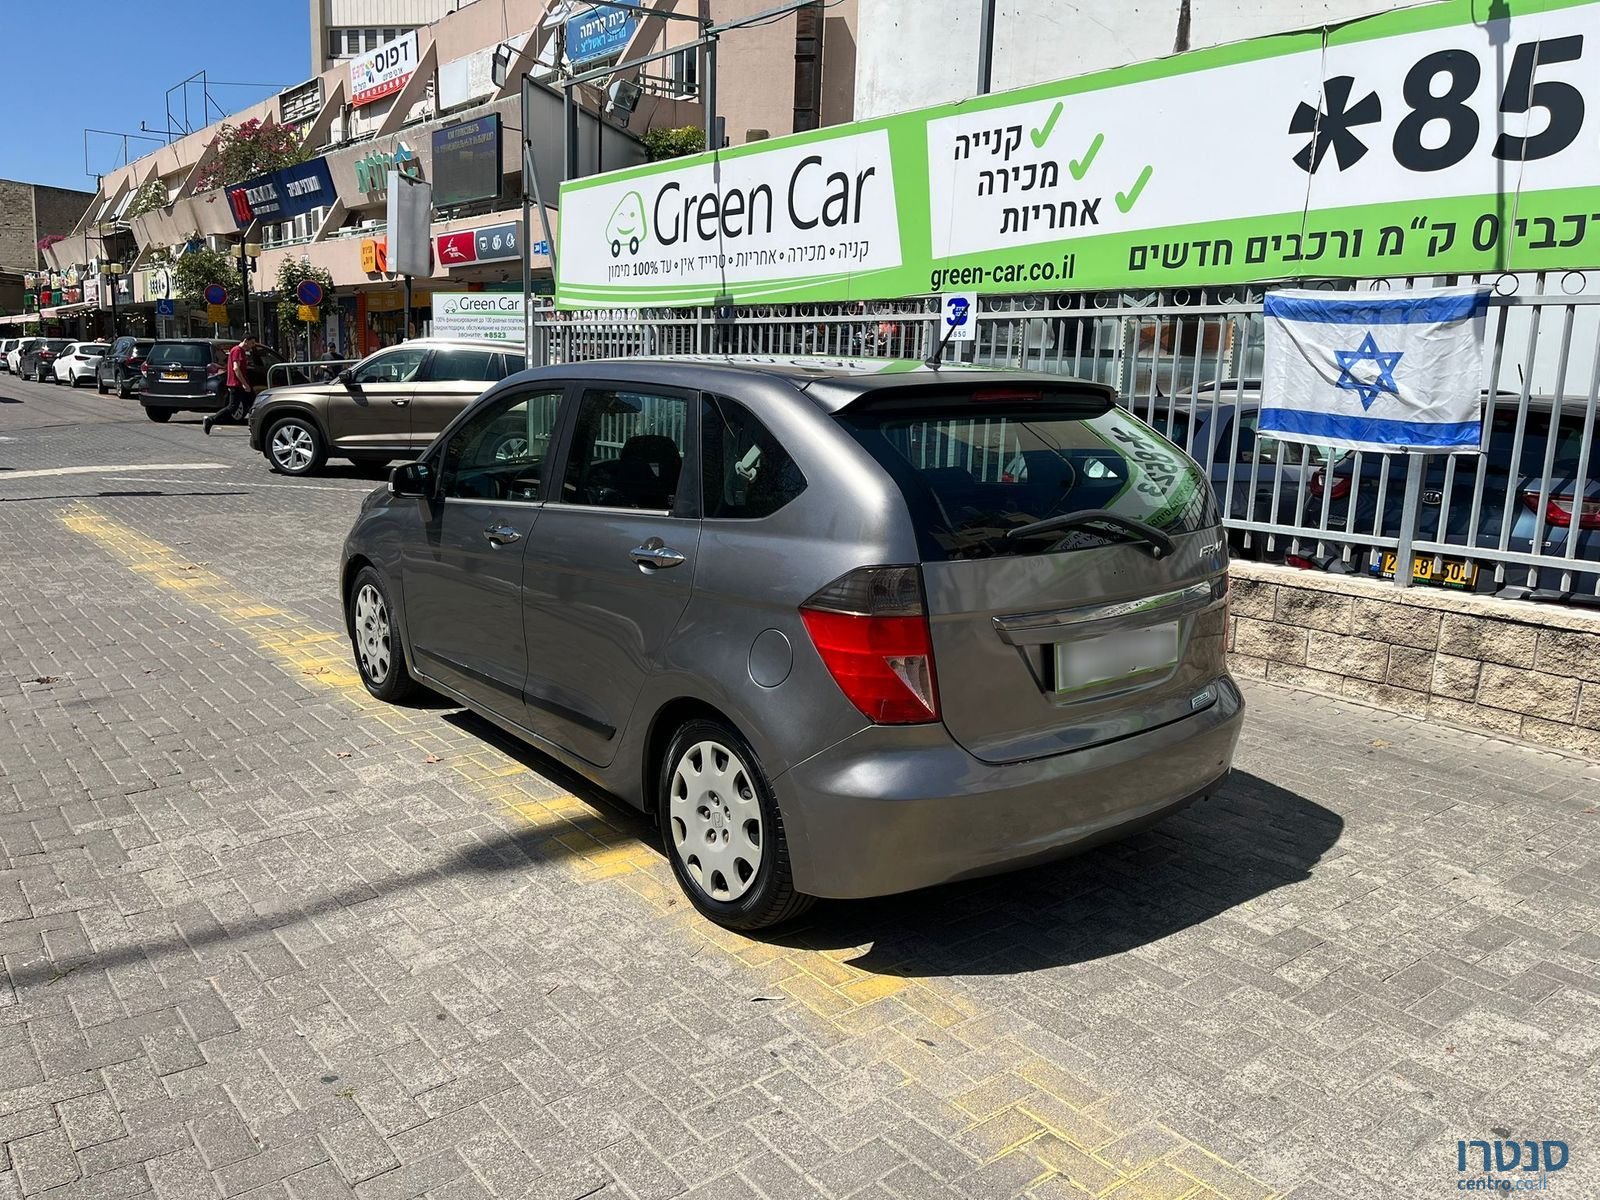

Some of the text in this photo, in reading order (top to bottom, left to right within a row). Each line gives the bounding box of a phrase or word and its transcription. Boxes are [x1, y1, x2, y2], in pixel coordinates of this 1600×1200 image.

[608, 10, 626, 28] בית
[374, 40, 409, 73] דפוס
[953, 124, 1023, 161] קנייה
[977, 160, 1059, 197] מכירה
[653, 155, 876, 247] Green Car
[999, 197, 1102, 234] אחריות
[1245, 227, 1363, 266] ורכבים
[1514, 213, 1600, 249] כבי
[608, 239, 870, 282] קניה מכירה אחריות טרייד אין עד 100% מימון
[930, 253, 1076, 291] green-car.co.il
[1128, 237, 1233, 271] חדשים
[459, 296, 520, 311] Green Car
